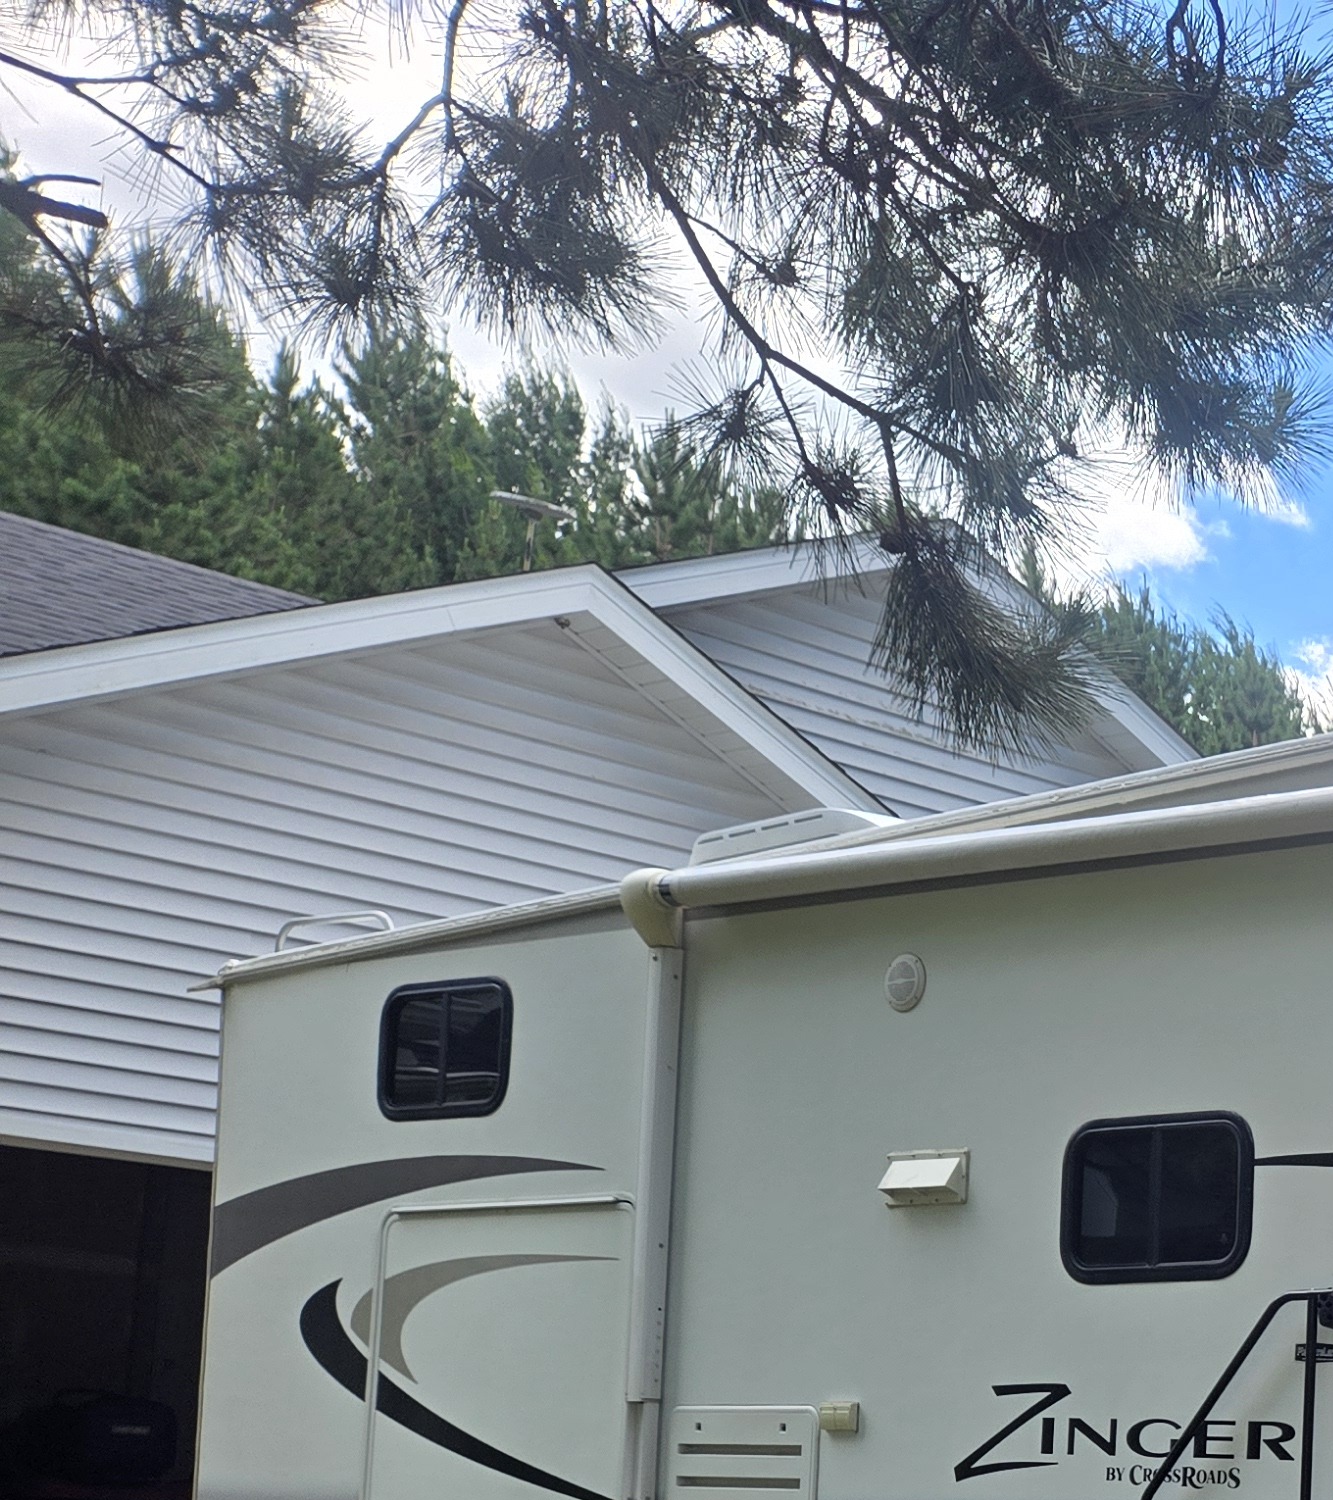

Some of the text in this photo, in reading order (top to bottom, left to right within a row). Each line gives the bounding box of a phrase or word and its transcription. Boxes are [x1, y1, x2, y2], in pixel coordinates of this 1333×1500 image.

[954, 1382, 1297, 1483] ZINGER
[1105, 1464, 1242, 1490] BY CRSSROADS
